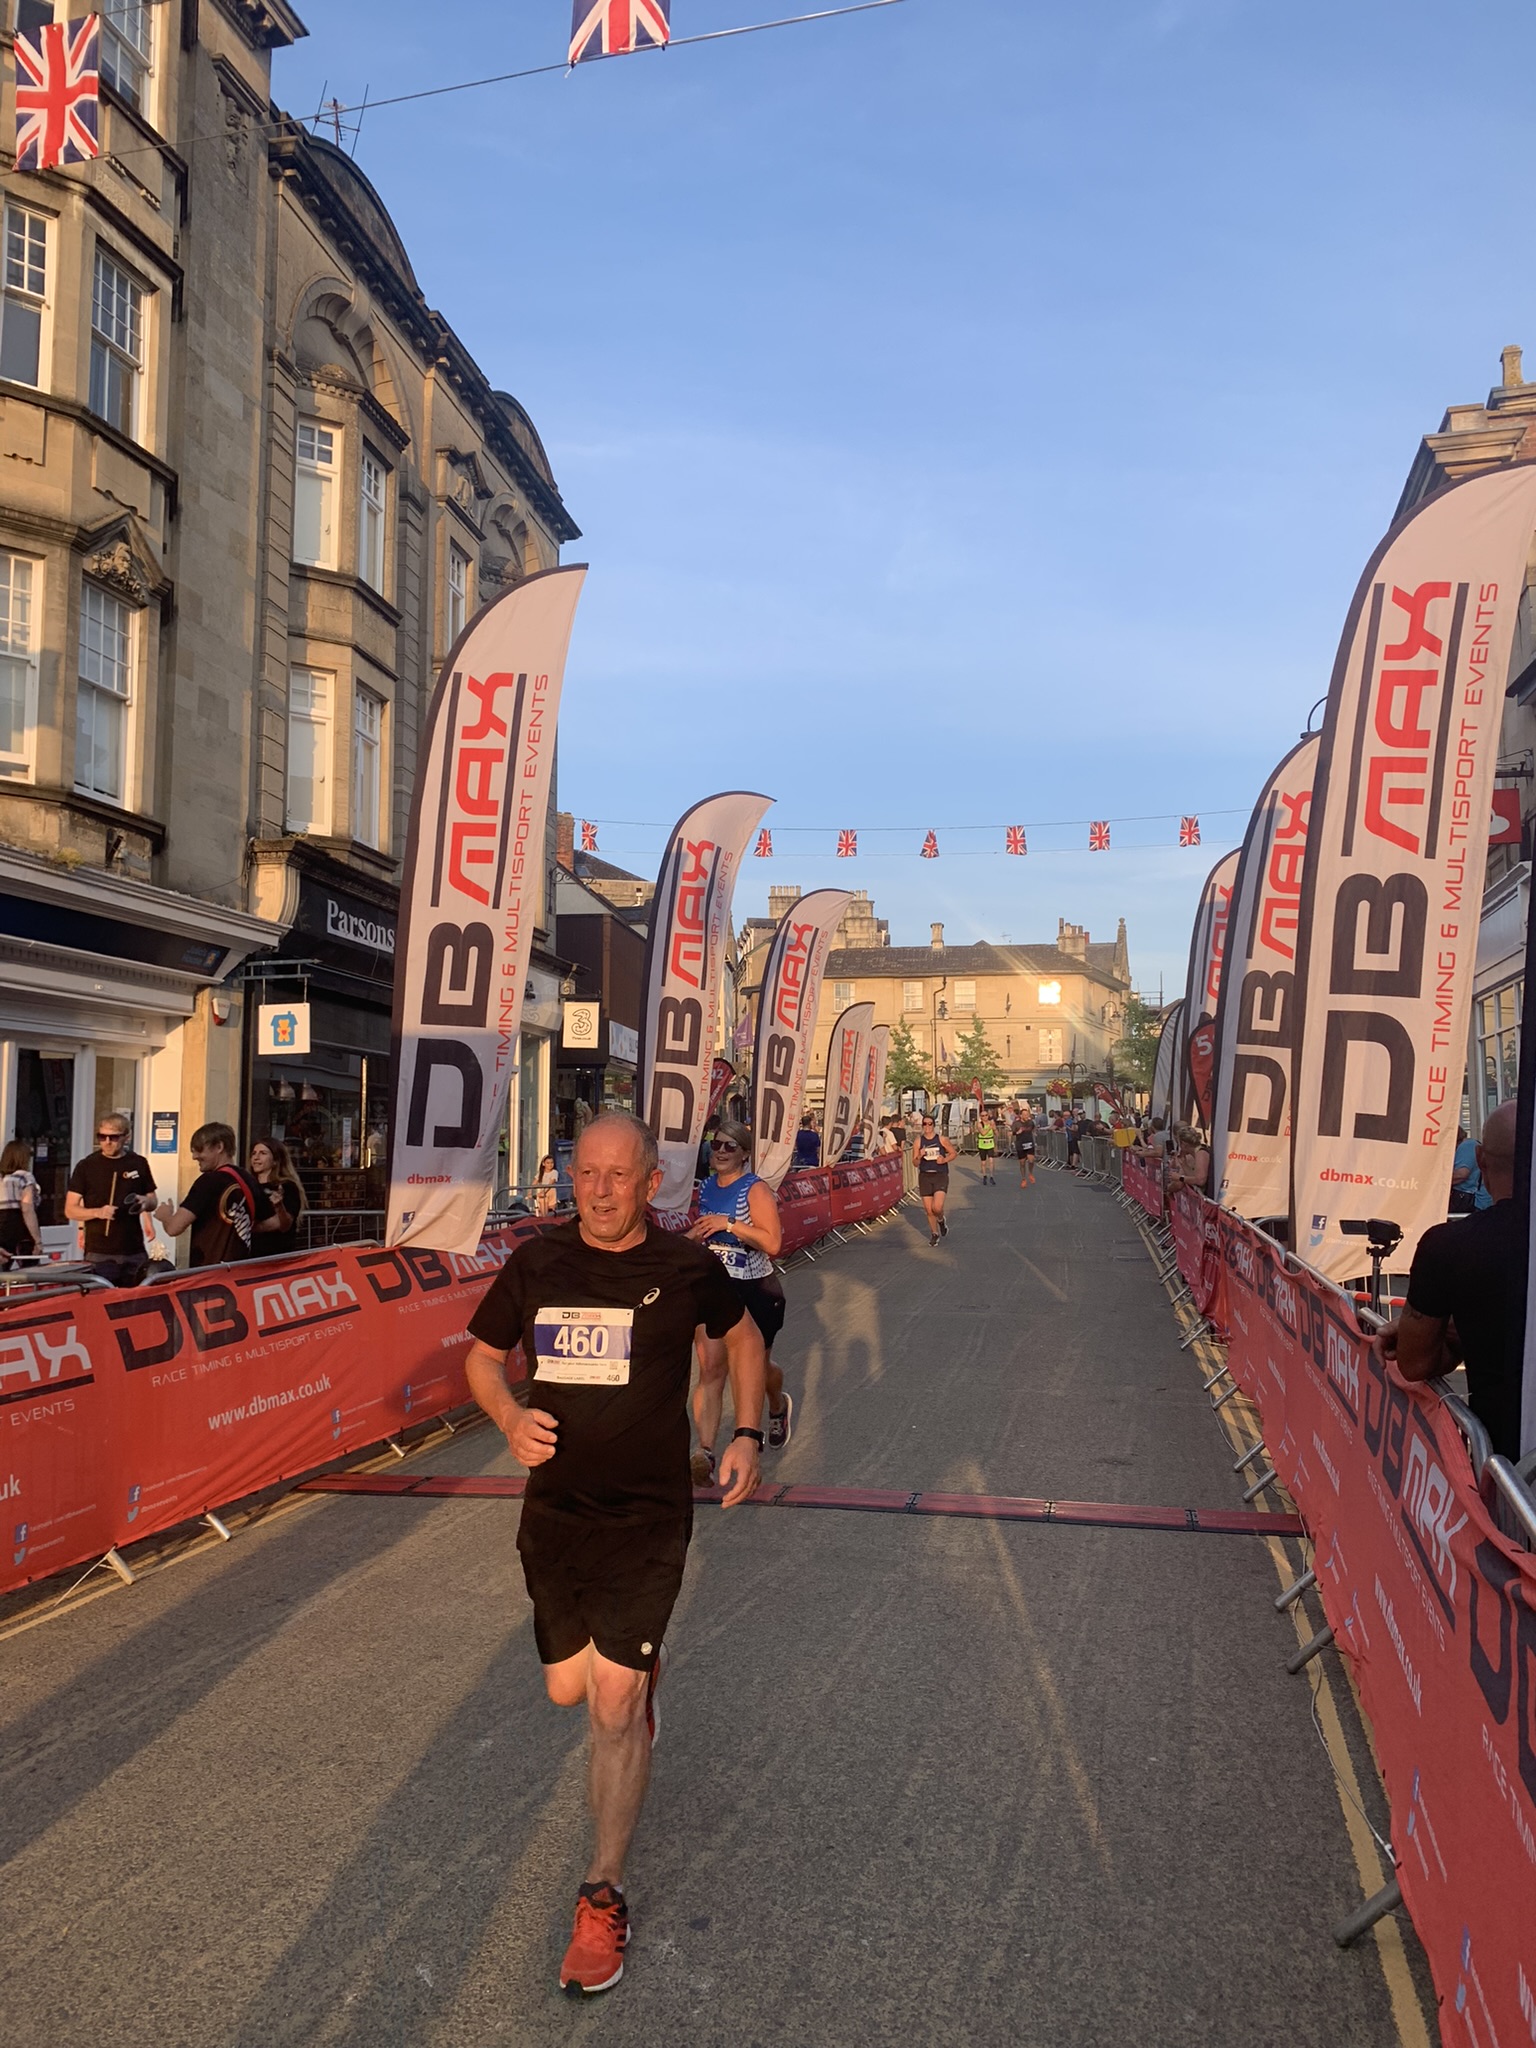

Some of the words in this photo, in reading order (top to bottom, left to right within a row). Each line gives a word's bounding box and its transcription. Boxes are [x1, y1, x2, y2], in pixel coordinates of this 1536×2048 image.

[1464, 582, 1498, 706] EVENTS
[523, 673, 549, 778] EVENTS
[1364, 581, 1452, 855] MAX
[448, 672, 514, 906] MAX
[1443, 718, 1479, 910] MULTISPORT
[504, 789, 534, 952] MULTISPORT
[671, 839, 715, 989] MAX
[327, 899, 395, 949] Parsons
[700, 1040, 714, 1096] TIMING
[707, 912, 722, 1018] MULTISPORT
[716, 850, 734, 910] EVENTS
[1440, 923, 1459, 939] &
[571, 1008, 593, 1036] 3
[776, 922, 814, 1030] MAX
[1318, 872, 1428, 1144] DB
[1431, 951, 1456, 1053] TIMING
[405, 921, 494, 1149] DB
[495, 987, 515, 1072] TIMING
[650, 996, 703, 1144] DB
[784, 1112, 796, 1145] RACE
[790, 1068, 804, 1109] TIMING
[811, 930, 829, 977] EVENTS
[1422, 1066, 1447, 1146] RACE
[1319, 1168, 1419, 1190] dbmax.co.uk
[0, 1325, 92, 1389] AX
[104, 1283, 250, 1372] DB
[253, 1270, 358, 1327] MAX
[152, 1367, 188, 1388] RACE
[191, 1355, 233, 1376] TIMING
[245, 1332, 312, 1360] MULTISPORT
[314, 1320, 354, 1340] EVENTS
[553, 1325, 609, 1358] 460
[10, 1398, 76, 1427] EVENTS
[208, 1373, 332, 1431] www.dbmax.co.uk
[606, 1374, 621, 1382] 460
[1482, 1723, 1507, 1801] RACE
